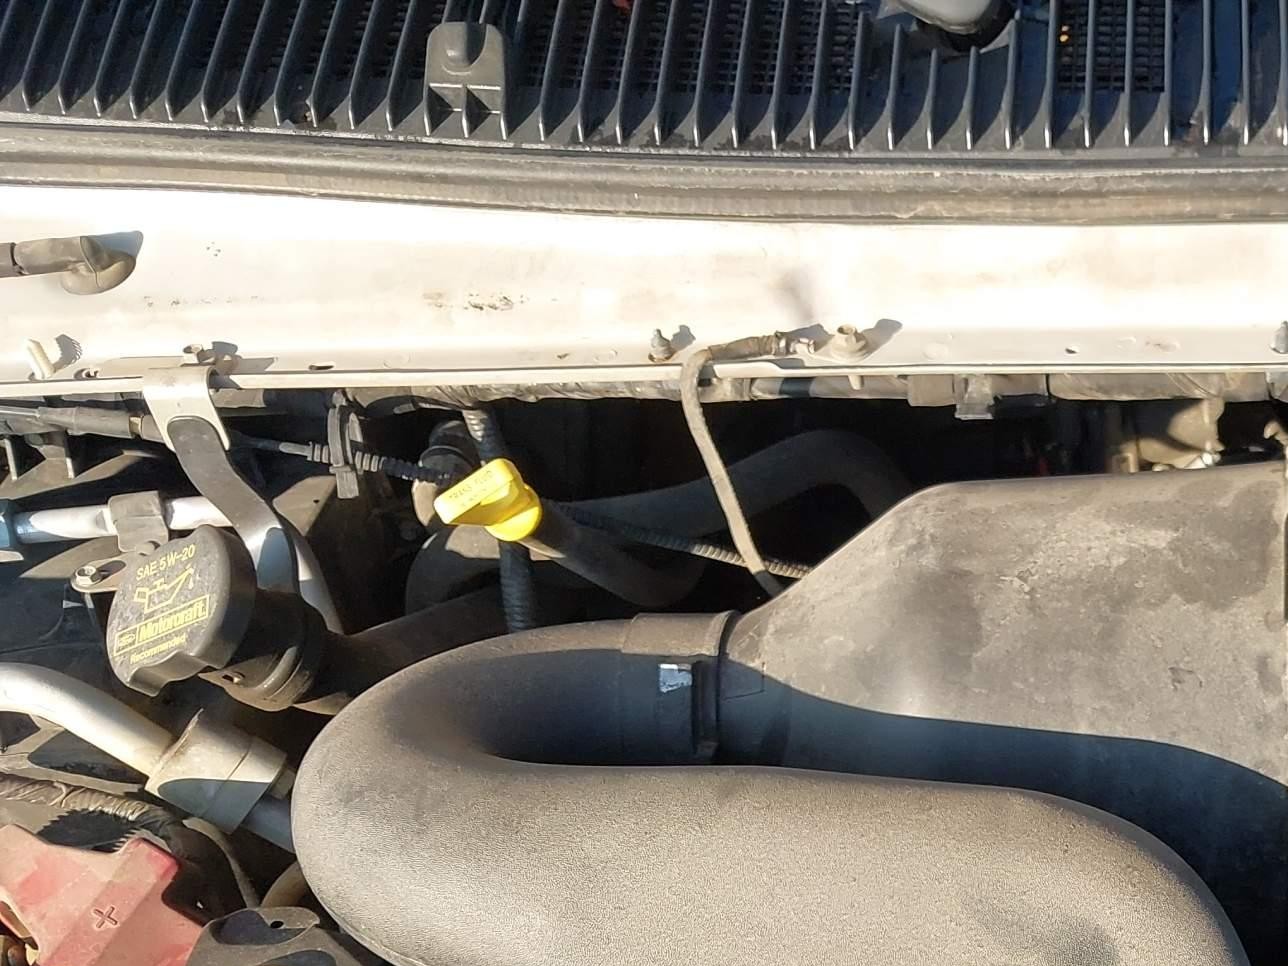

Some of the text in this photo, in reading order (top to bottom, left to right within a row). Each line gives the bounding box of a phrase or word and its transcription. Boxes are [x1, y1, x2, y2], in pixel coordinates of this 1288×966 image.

[136, 544, 196, 581] SAE 5W-20
[139, 602, 206, 642] Motorcraft
